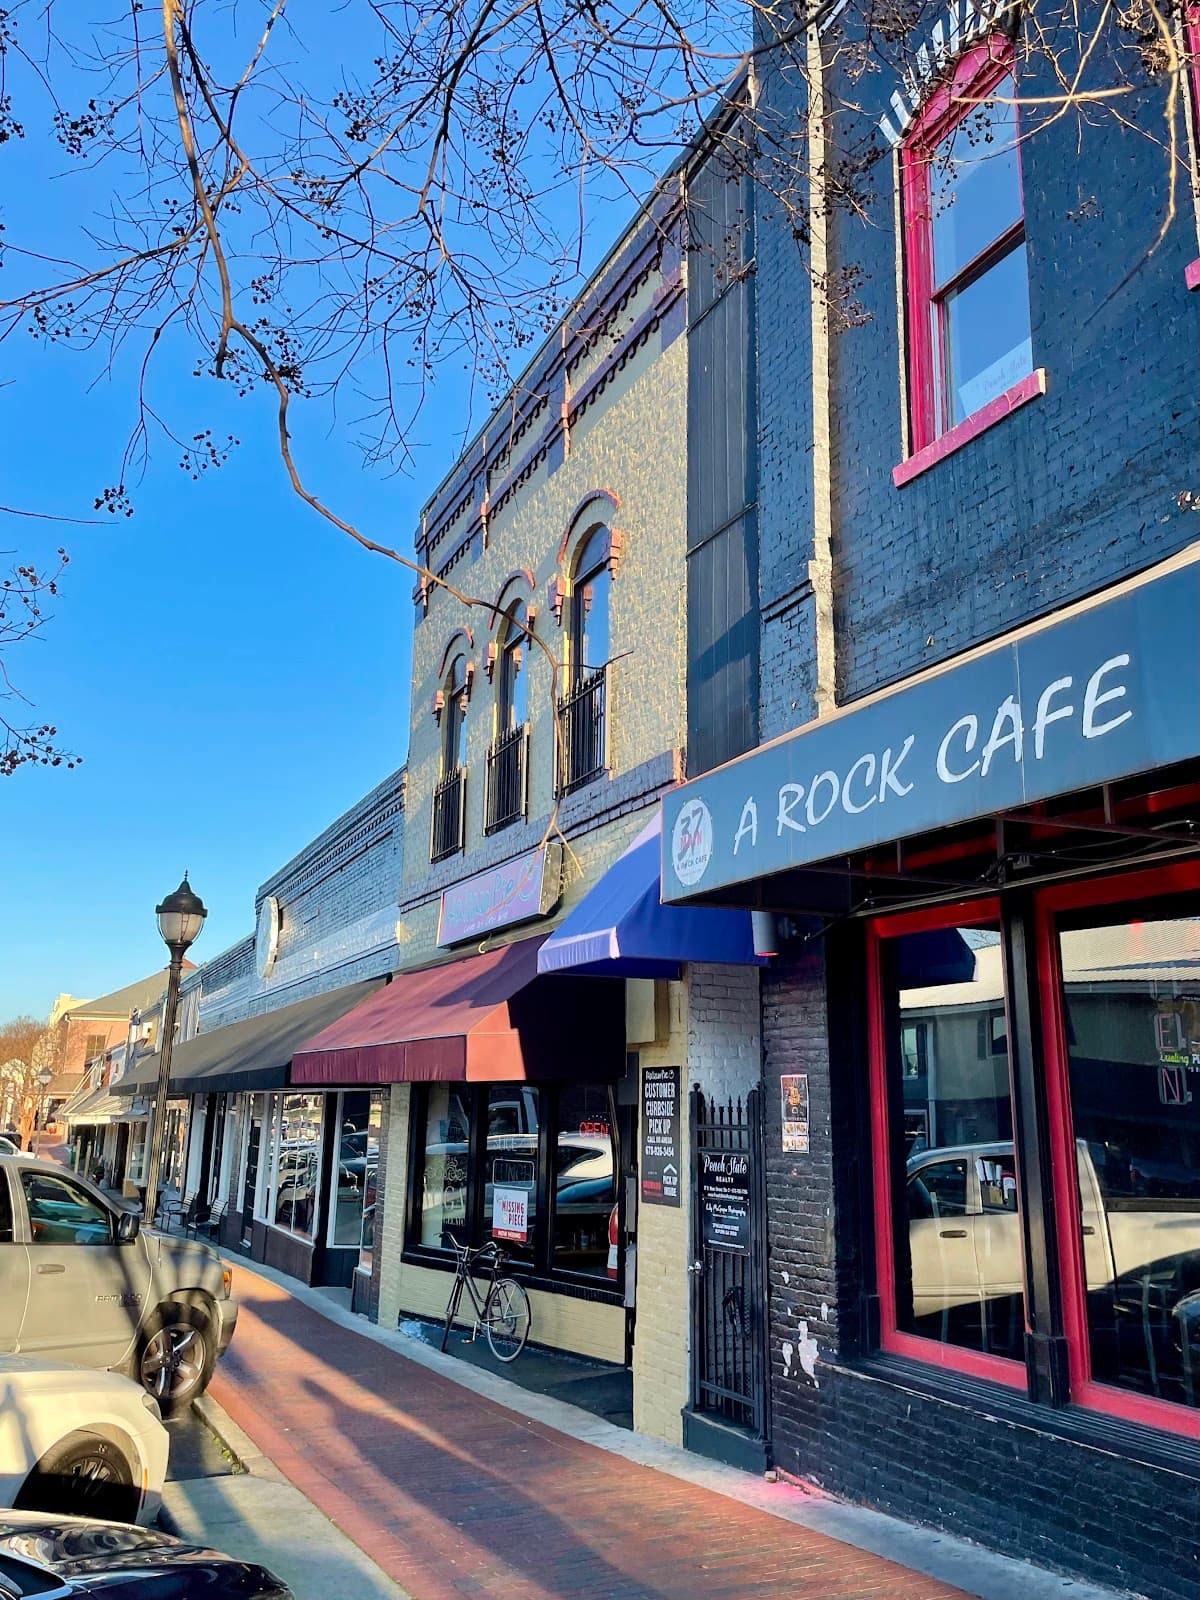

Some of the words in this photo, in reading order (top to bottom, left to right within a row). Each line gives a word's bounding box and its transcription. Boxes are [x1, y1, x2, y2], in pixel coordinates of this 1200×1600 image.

[732, 796, 758, 856] A
[776, 734, 915, 838] ROCK
[936, 653, 1134, 784] CAFE
[677, 806, 704, 862] 37
[644, 1082, 676, 1098] CUSTOMER
[645, 1100, 674, 1117] CURBSIDE
[579, 1121, 609, 1140] OPEN
[648, 1118, 662, 1134] PICK
[662, 1118, 671, 1135] UP
[703, 1153, 726, 1174] Peach
[726, 1156, 747, 1176] State
[715, 1175, 734, 1184] REALTY
[502, 1200, 525, 1214] MISSING
[508, 1213, 524, 1227] PIECE
